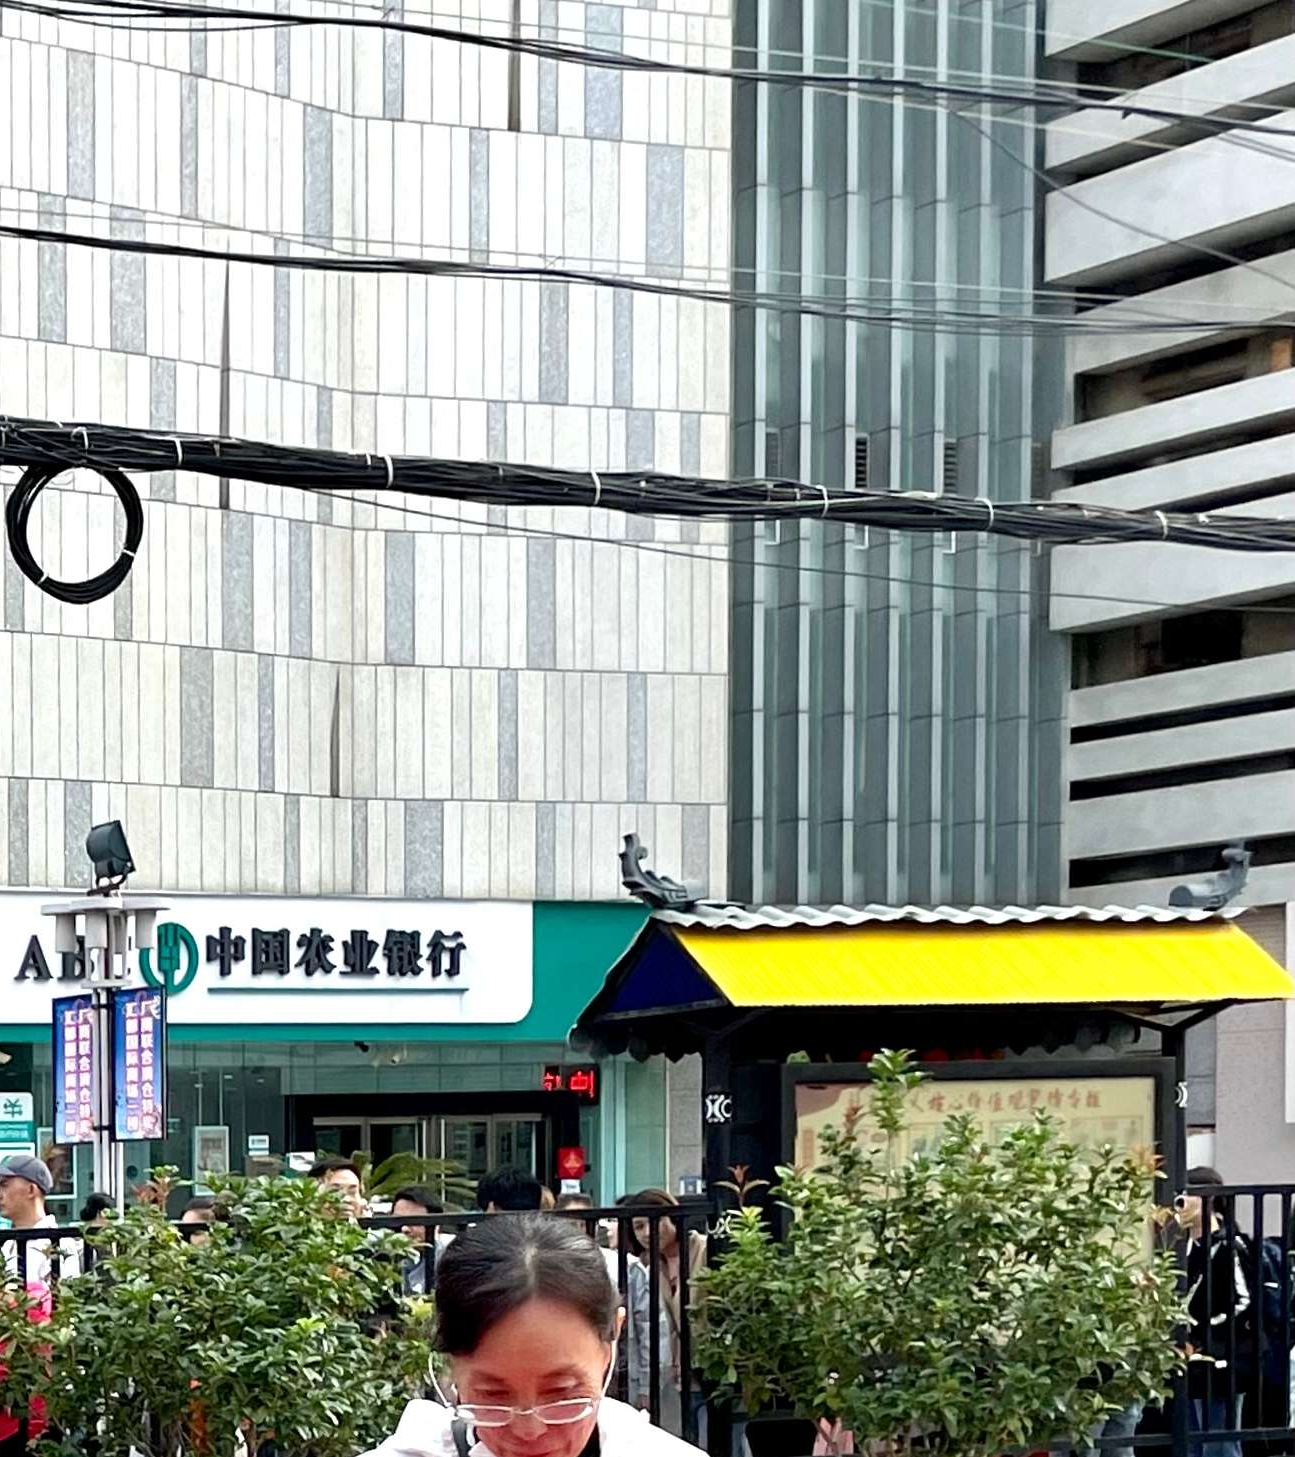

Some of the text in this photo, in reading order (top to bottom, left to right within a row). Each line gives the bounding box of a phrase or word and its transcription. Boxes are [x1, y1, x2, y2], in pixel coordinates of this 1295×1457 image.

[14, 934, 132, 981] AB
[206, 926, 467, 978] 中国农业银行
